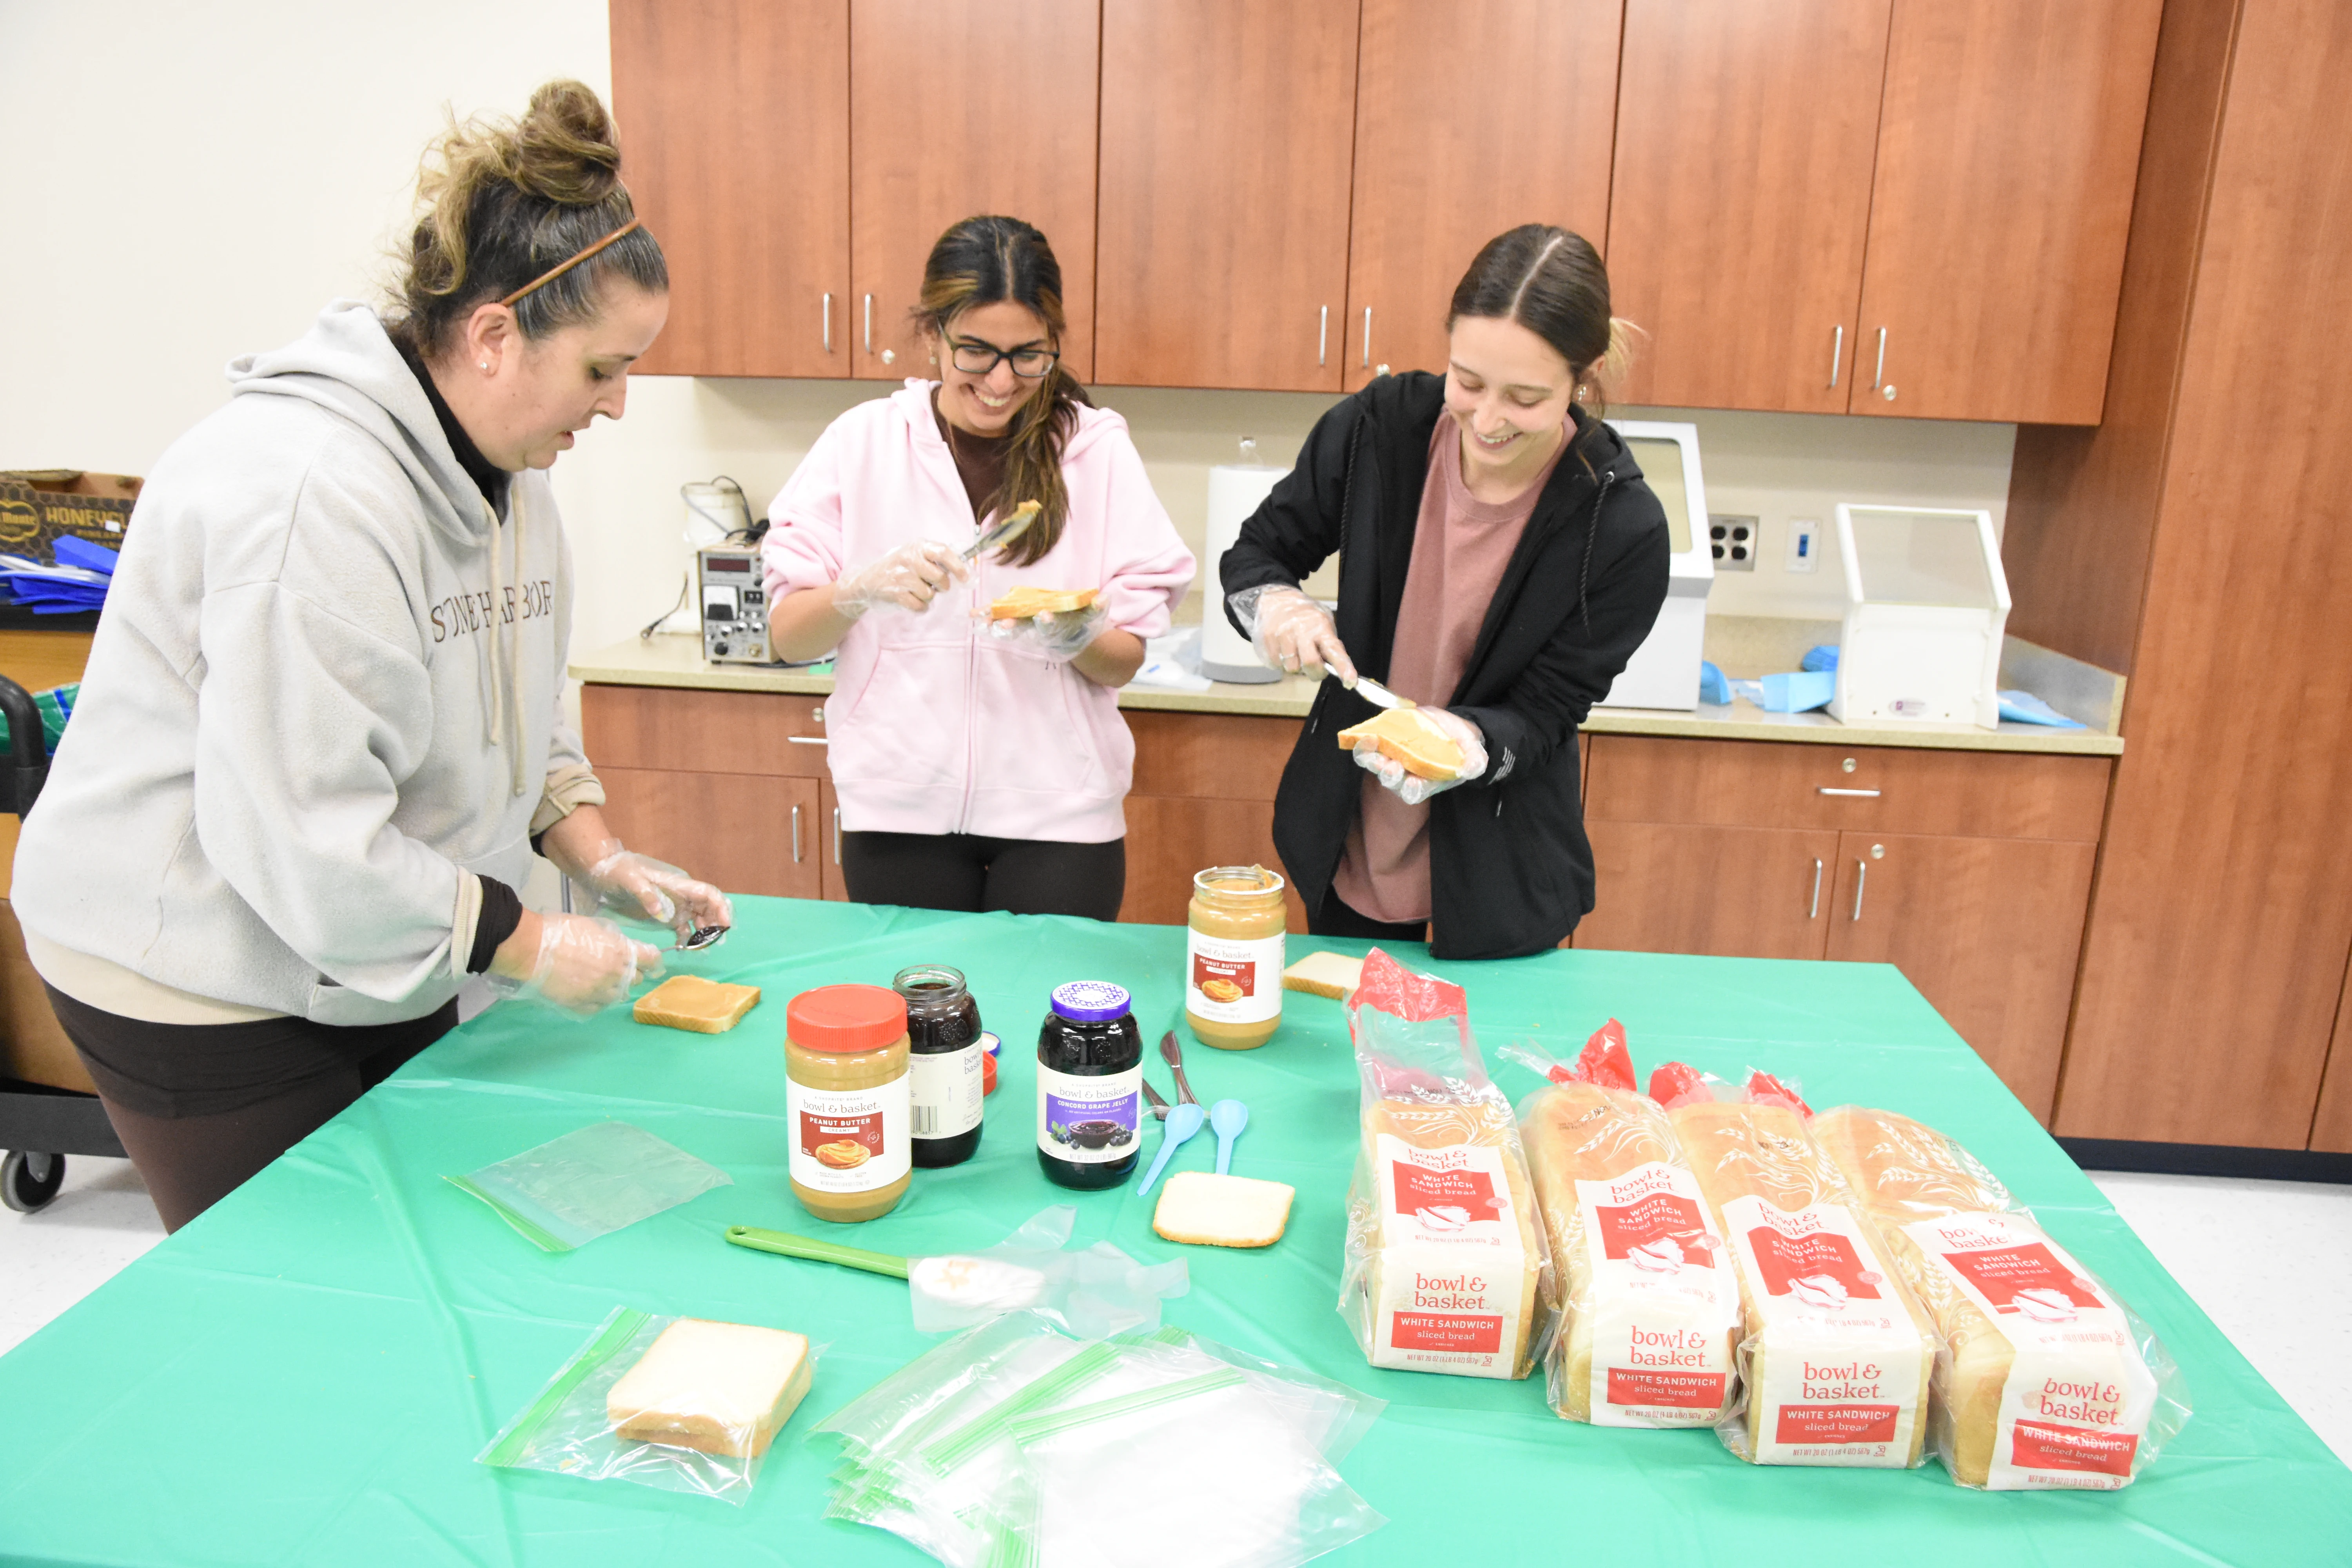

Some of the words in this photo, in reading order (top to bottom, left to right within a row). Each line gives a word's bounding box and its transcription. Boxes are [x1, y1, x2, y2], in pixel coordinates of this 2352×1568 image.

[45, 506, 131, 529] HONEYGL
[1223, 950, 1250, 959] basket
[1200, 958, 1220, 967] PEANUT
[1059, 1087, 1082, 1098] bowl
[1096, 1087, 1127, 1098] basket
[804, 1099, 825, 1112] bowl
[828, 1105, 837, 1113] &
[840, 1102, 877, 1113] basket
[1058, 1100, 1086, 1109] CONCORD
[1112, 1098, 1129, 1107] JELLY
[809, 1117, 838, 1126] PEANUT
[1408, 1148, 1449, 1161] bowl
[1410, 1155, 1469, 1169] basket
[1411, 1177, 1473, 1188] SANDWICH
[1422, 1174, 1459, 1182] WHITE
[1610, 1170, 1653, 1194] bowl
[1655, 1169, 1670, 1179] &
[1409, 1184, 1441, 1194] sliced
[1612, 1181, 1674, 1203] basket
[1630, 1199, 1667, 1216] WHITE
[1757, 1202, 1800, 1226] bowl
[1802, 1213, 1817, 1221] &
[1618, 1207, 1682, 1223] SANDWICH
[1617, 1221, 1651, 1230] sliced
[1654, 1216, 1686, 1225] bread
[1761, 1212, 1825, 1235] basket
[1937, 1227, 1980, 1239] bow
[1772, 1240, 1837, 1256] SANDWICH
[1781, 1239, 1819, 1250] WHITE
[1773, 1250, 1806, 1263] sliced
[1979, 1254, 2021, 1263] WHITE
[1974, 1259, 2041, 1270] SANDWICH
[1980, 1269, 2014, 1278] sliced
[1416, 1272, 1465, 1291] bowl
[1469, 1277, 1487, 1292] &
[1414, 1291, 1485, 1309] basket
[1401, 1318, 1434, 1327] WHITE
[1437, 1320, 1494, 1329] SANDWICH
[1417, 1330, 1445, 1339] sliced
[1631, 1325, 1684, 1349] bowl
[1688, 1332, 1707, 1348] &
[1630, 1346, 1706, 1367] basket
[1803, 1362, 1858, 1380] bowl
[1862, 1364, 1882, 1379] &
[1616, 1372, 1653, 1383] WHITE
[1656, 1376, 1717, 1387] SANDWICH
[1634, 1385, 1664, 1394] sliced
[1668, 1388, 1697, 1396] bread
[1802, 1382, 1880, 1399] basket
[2043, 1377, 2099, 1401] bowl
[2103, 1385, 2120, 1403] &
[1787, 1411, 1824, 1419] WHITE
[1828, 1410, 1890, 1420] SANDWICH
[2040, 1395, 2118, 1426] basket
[1804, 1423, 1835, 1431] sliced
[1838, 1423, 1869, 1432] bread
[2023, 1426, 2061, 1443] WHITE
[2065, 1434, 2130, 1451] SANDWICH
[2040, 1445, 2073, 1456] sliced
[2075, 1450, 2107, 1462] bread
